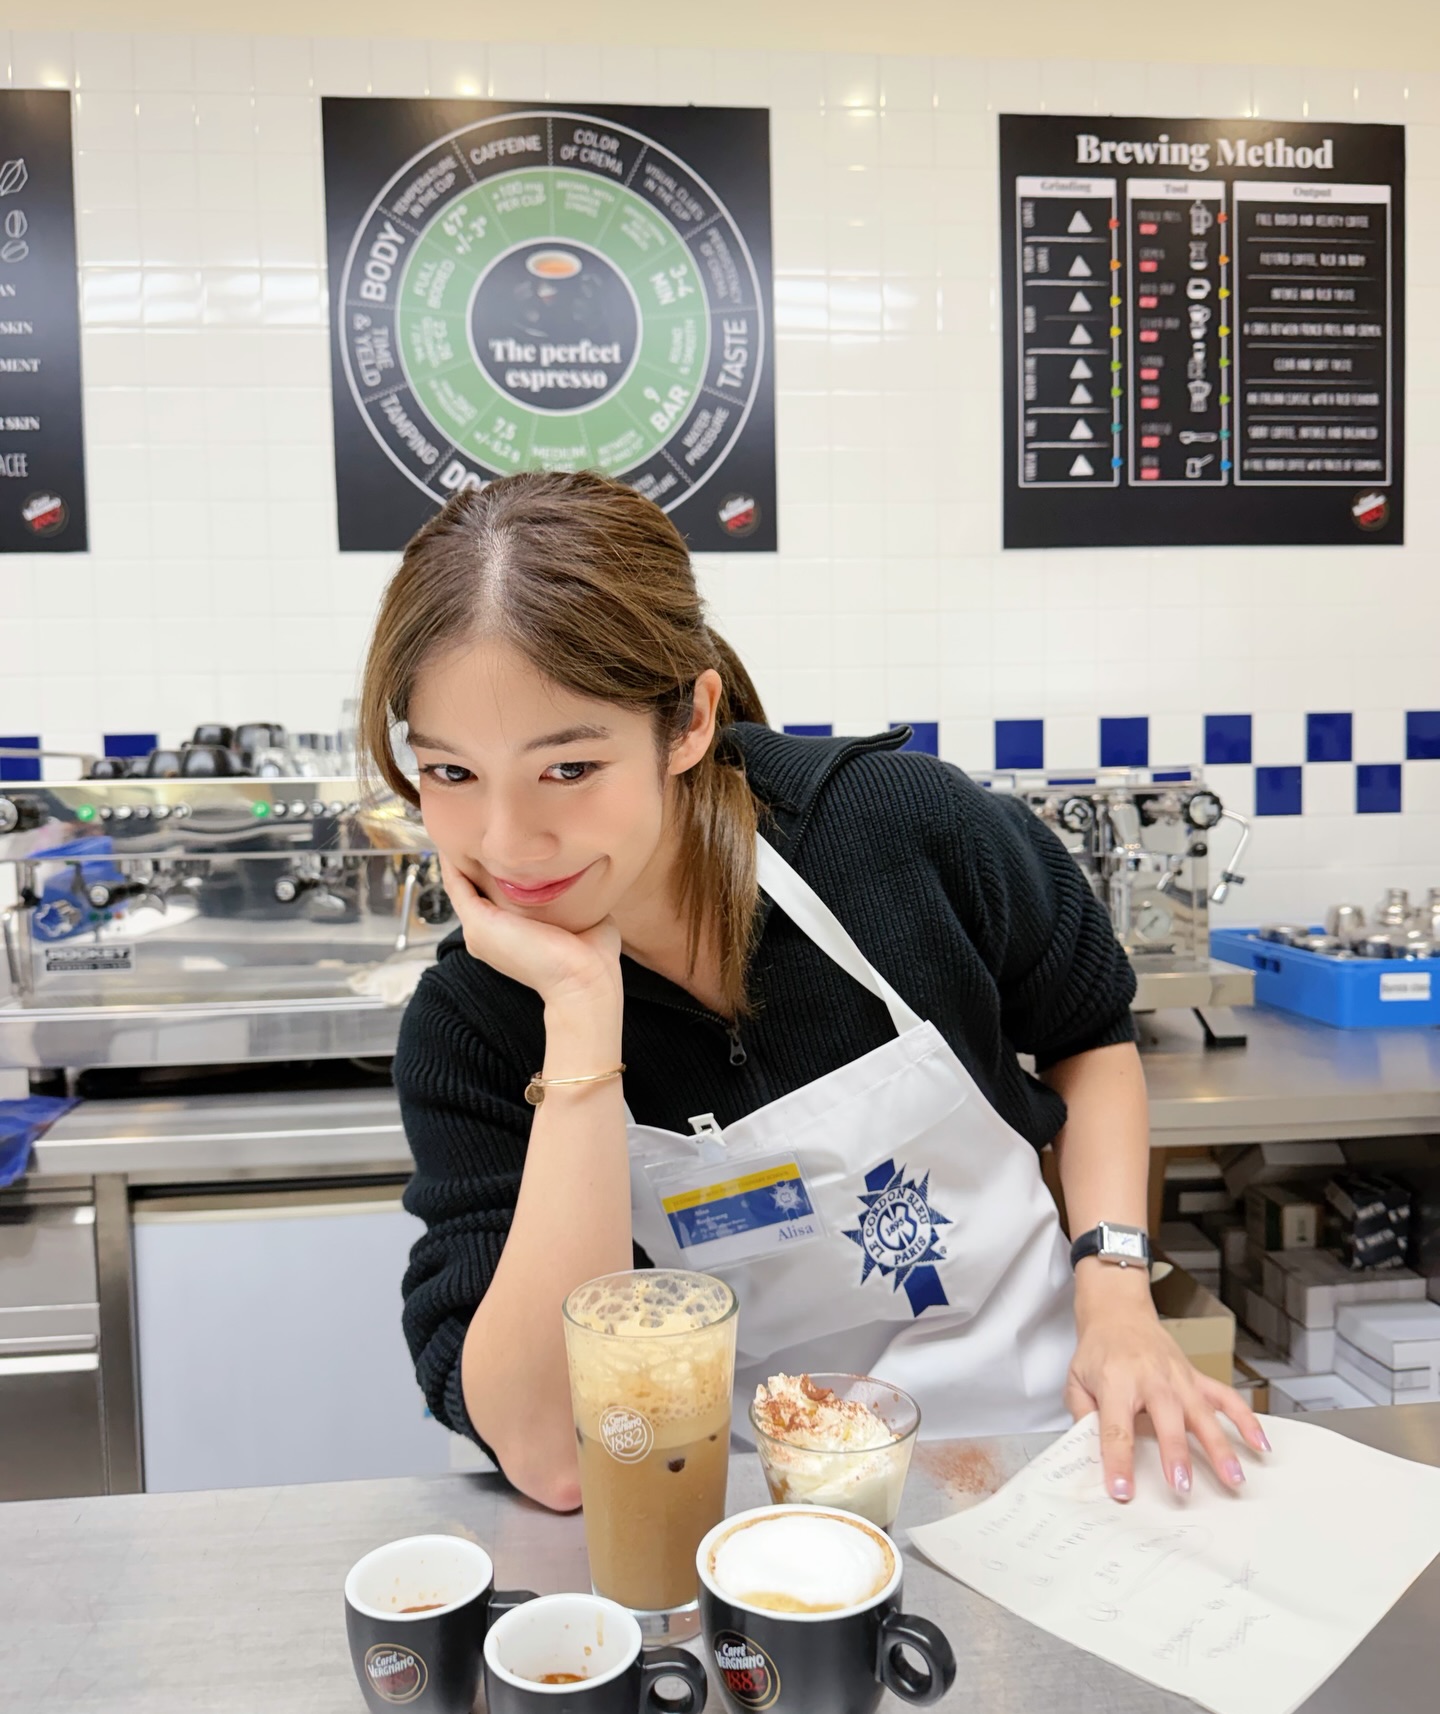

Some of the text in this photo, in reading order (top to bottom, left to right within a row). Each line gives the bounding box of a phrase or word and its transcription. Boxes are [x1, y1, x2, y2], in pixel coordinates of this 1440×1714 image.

[470, 134, 543, 165] CAFFEINE
[573, 128, 620, 155] COLOR
[1075, 134, 1334, 172] Brewing Method
[560, 144, 623, 176] OF CREMA
[1163, 184, 1189, 194] Tool
[1293, 187, 1332, 198] Output
[359, 220, 405, 303] BODY
[371, 326, 395, 371] TIME
[488, 336, 622, 367] The perfect
[716, 318, 748, 388] TASTE
[505, 369, 608, 393] espresso
[650, 384, 690, 433] BAR
[379, 392, 440, 465] TAMPING
[439, 458, 491, 494] DO
[778, 1224, 814, 1242] Alisa
[865, 1188, 930, 1259] LE CORDON BLEU
[885, 1218, 905, 1236] 1895
[894, 1235, 928, 1266] PARIS
[611, 1427, 644, 1453] 1882
[368, 1655, 415, 1678] VERGNANO
[715, 1654, 765, 1670] VERGNANO
[726, 1667, 766, 1692] 1882
